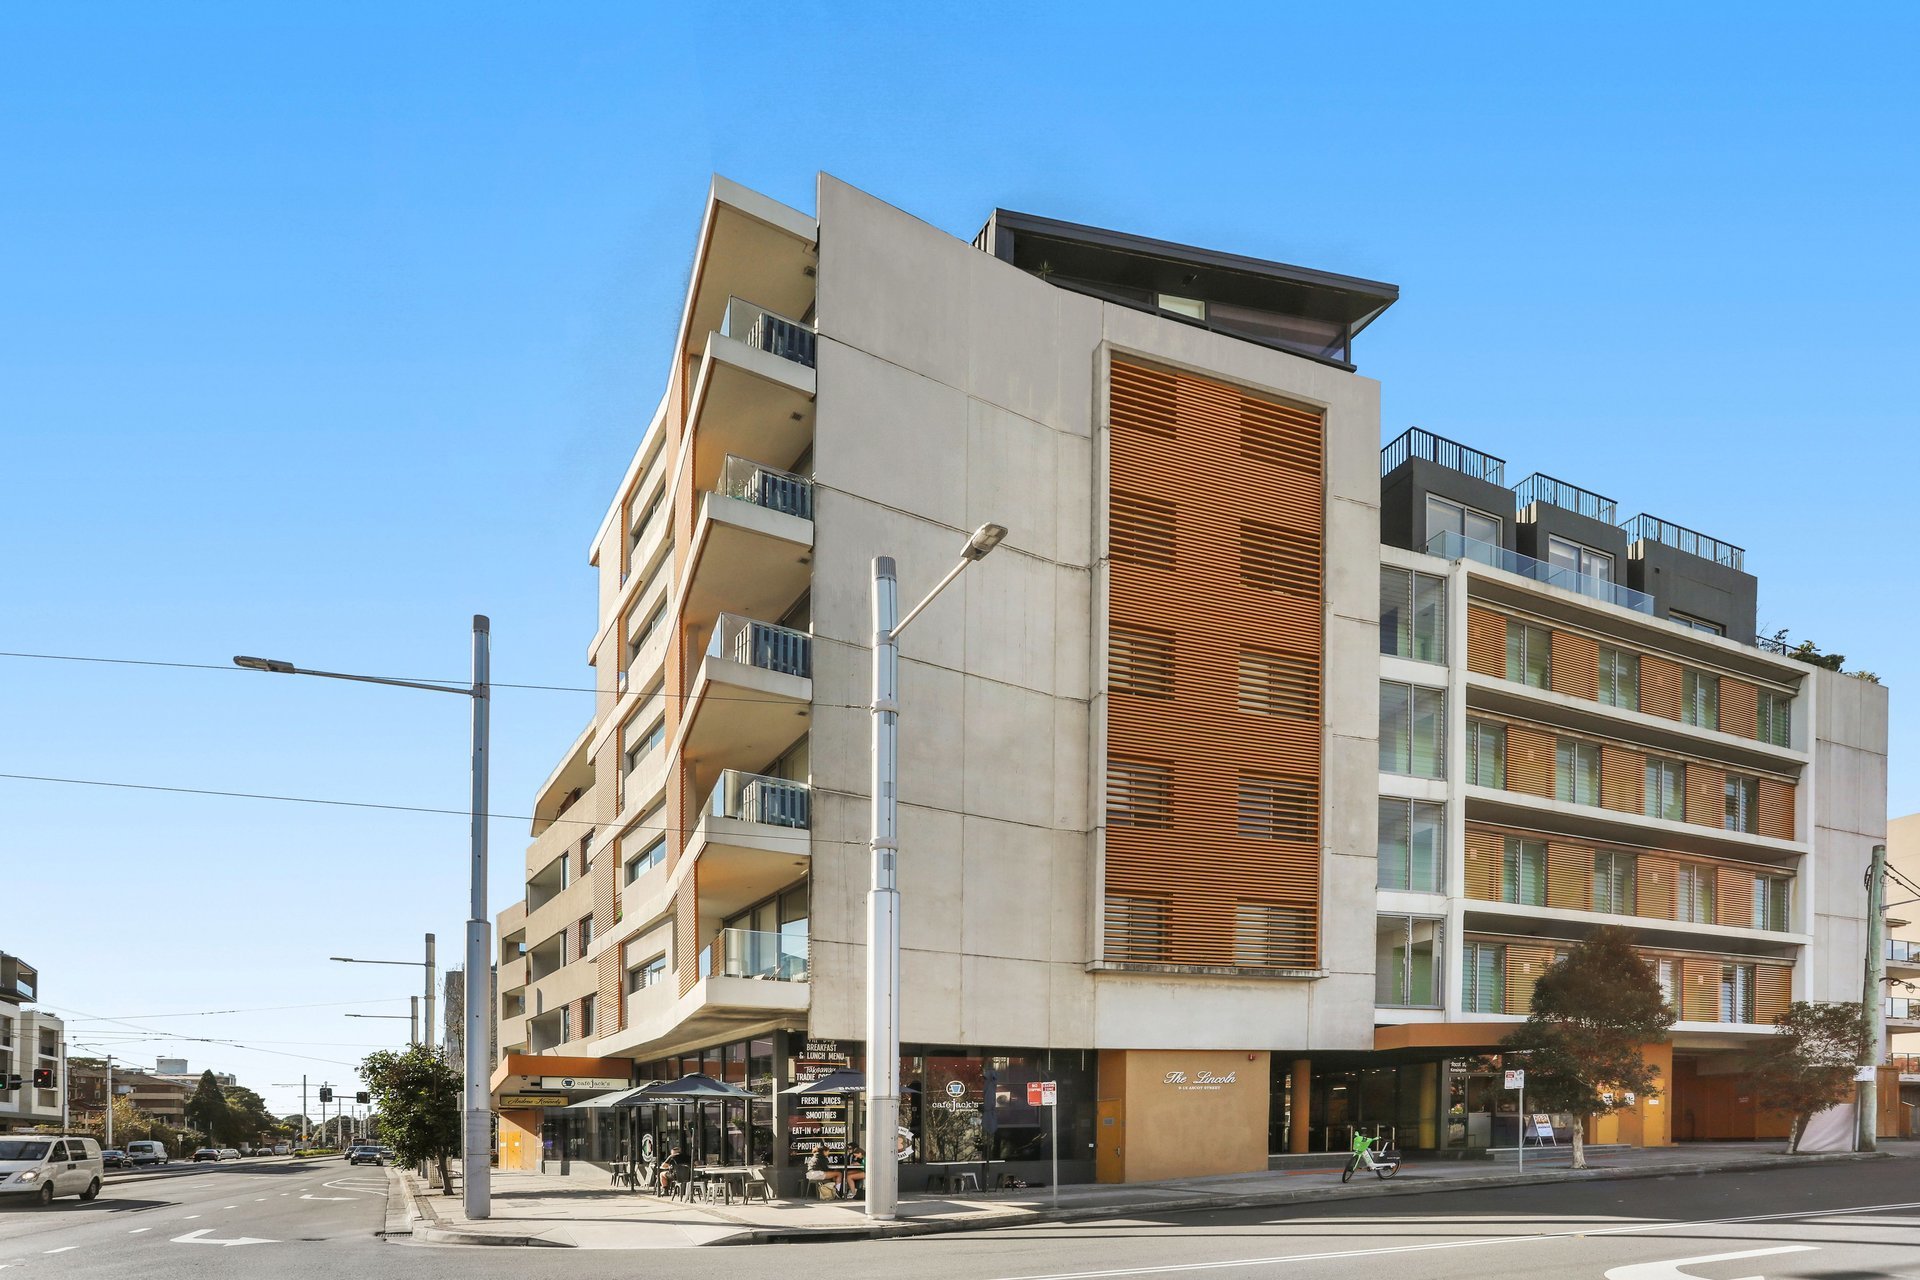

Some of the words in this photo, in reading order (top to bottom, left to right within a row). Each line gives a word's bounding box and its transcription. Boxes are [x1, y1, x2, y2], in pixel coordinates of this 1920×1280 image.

[806, 1044, 837, 1052] BREAKFAST
[799, 1051, 805, 1059] &
[806, 1052, 826, 1060] LUNCH
[828, 1052, 845, 1060] MENU
[796, 1073, 816, 1081] TRADIE
[1163, 1071, 1187, 1084] The
[1192, 1070, 1237, 1084] Lincoln
[801, 1097, 819, 1105] FRESH
[821, 1097, 841, 1105] JUICES
[805, 1111, 837, 1119] SMOOTHIES
[792, 1126, 812, 1135] EAT-IN
[797, 1142, 821, 1150] PROTEIN
[824, 1142, 845, 1150] SHAKES
